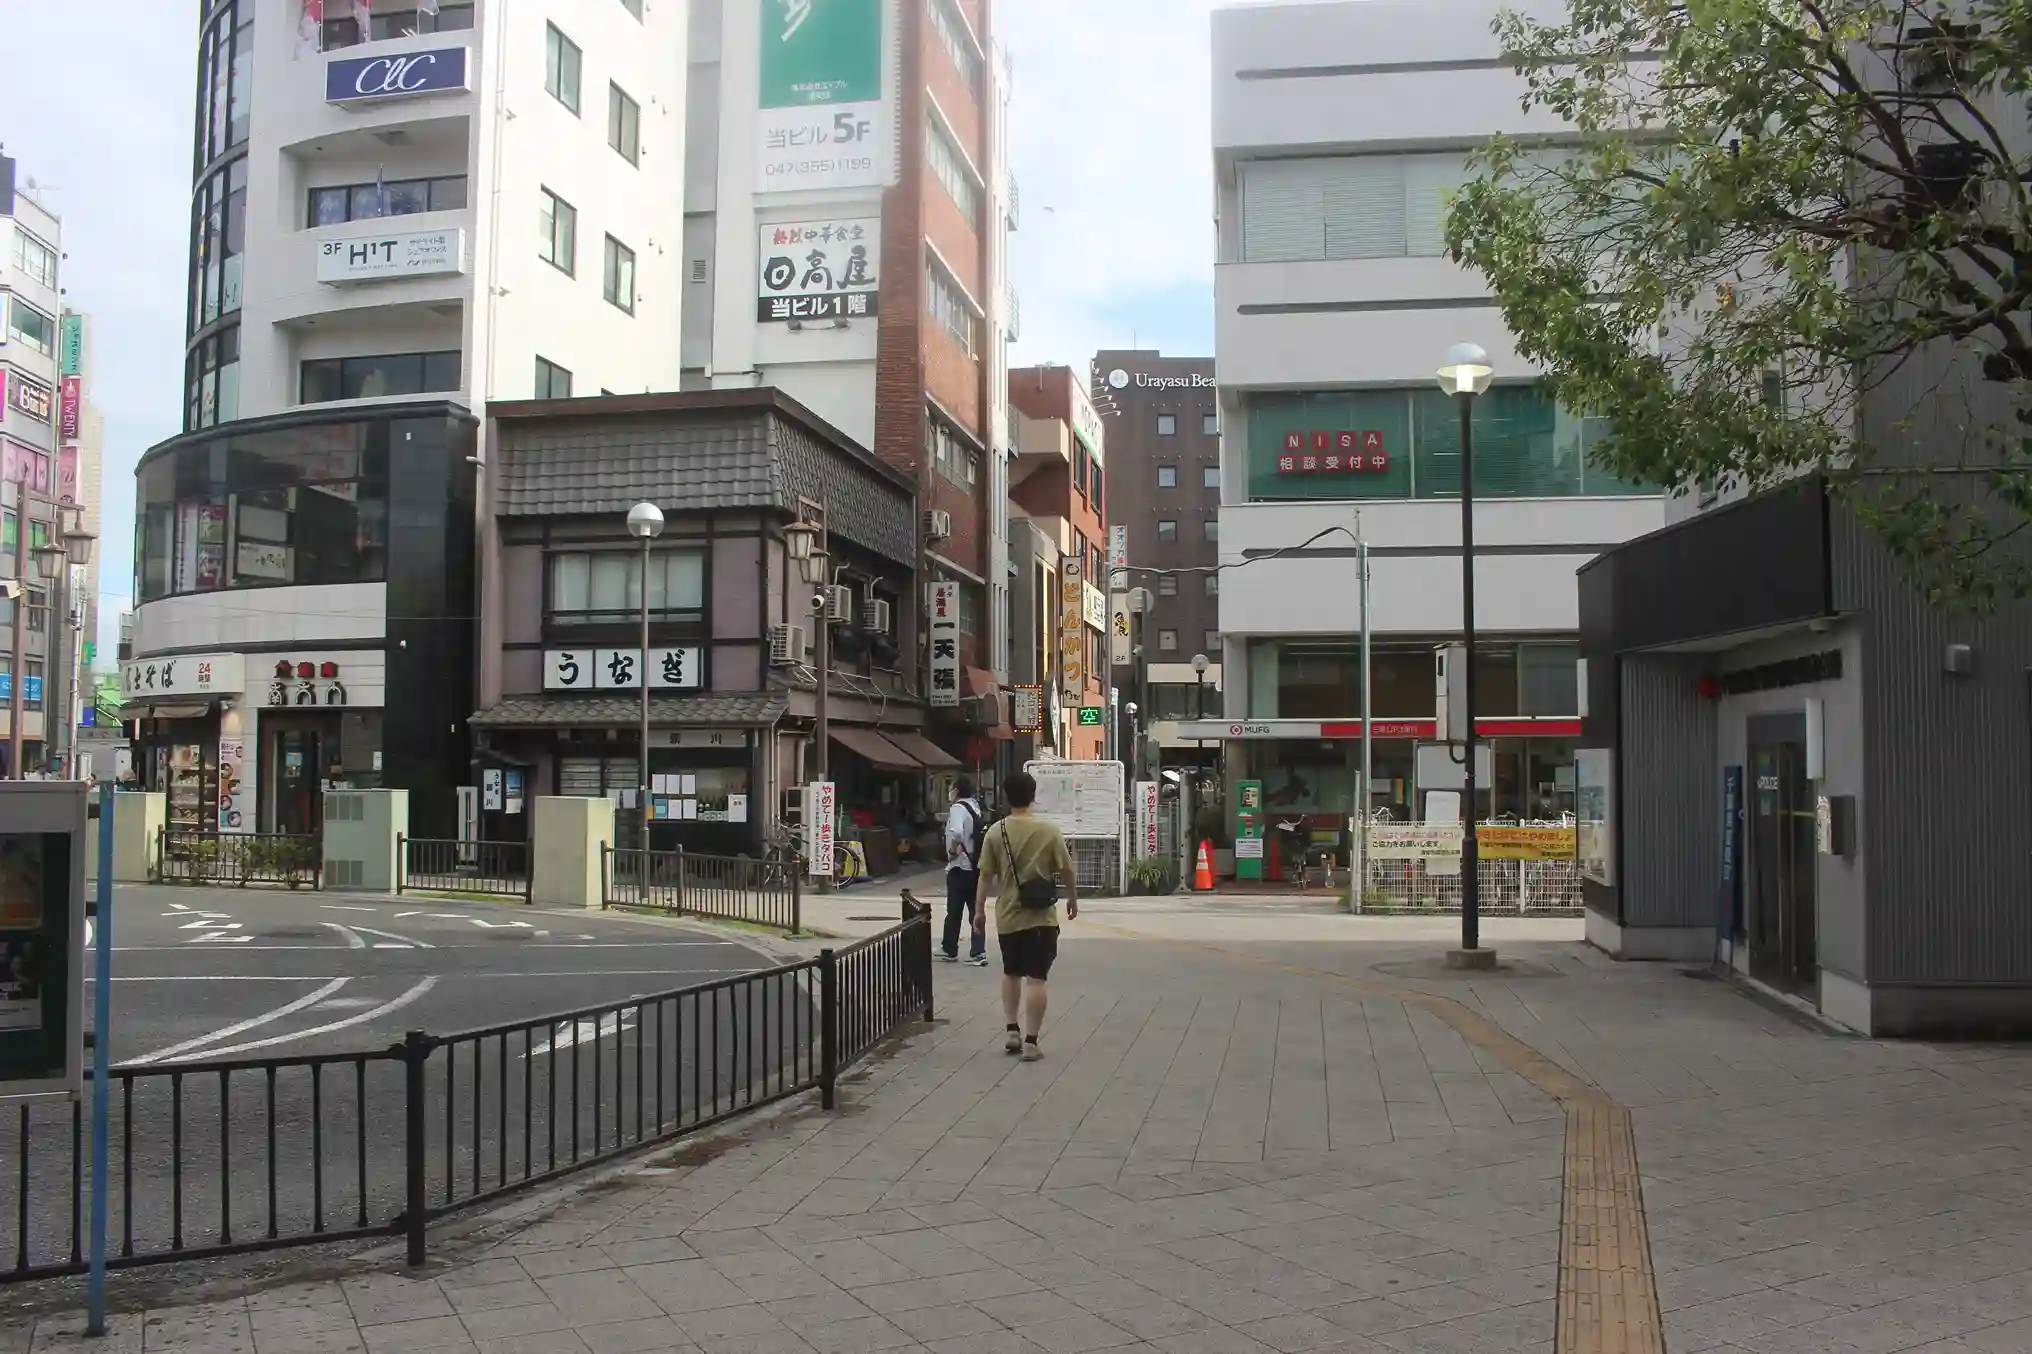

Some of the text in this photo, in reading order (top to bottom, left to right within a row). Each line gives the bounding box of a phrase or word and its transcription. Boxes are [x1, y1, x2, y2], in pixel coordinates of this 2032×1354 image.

[765, 112, 871, 149] 当ビル 5F
[323, 242, 342, 256] 3F
[764, 244, 876, 291] 日高屋
[1134, 373, 1189, 391] Urayasu
[1280, 455, 1386, 470] 相談受付中
[198, 663, 211, 674] 24
[558, 649, 686, 686] うなぎ
[1080, 707, 1099, 725] 空
[1244, 726, 1270, 735] MUFG
